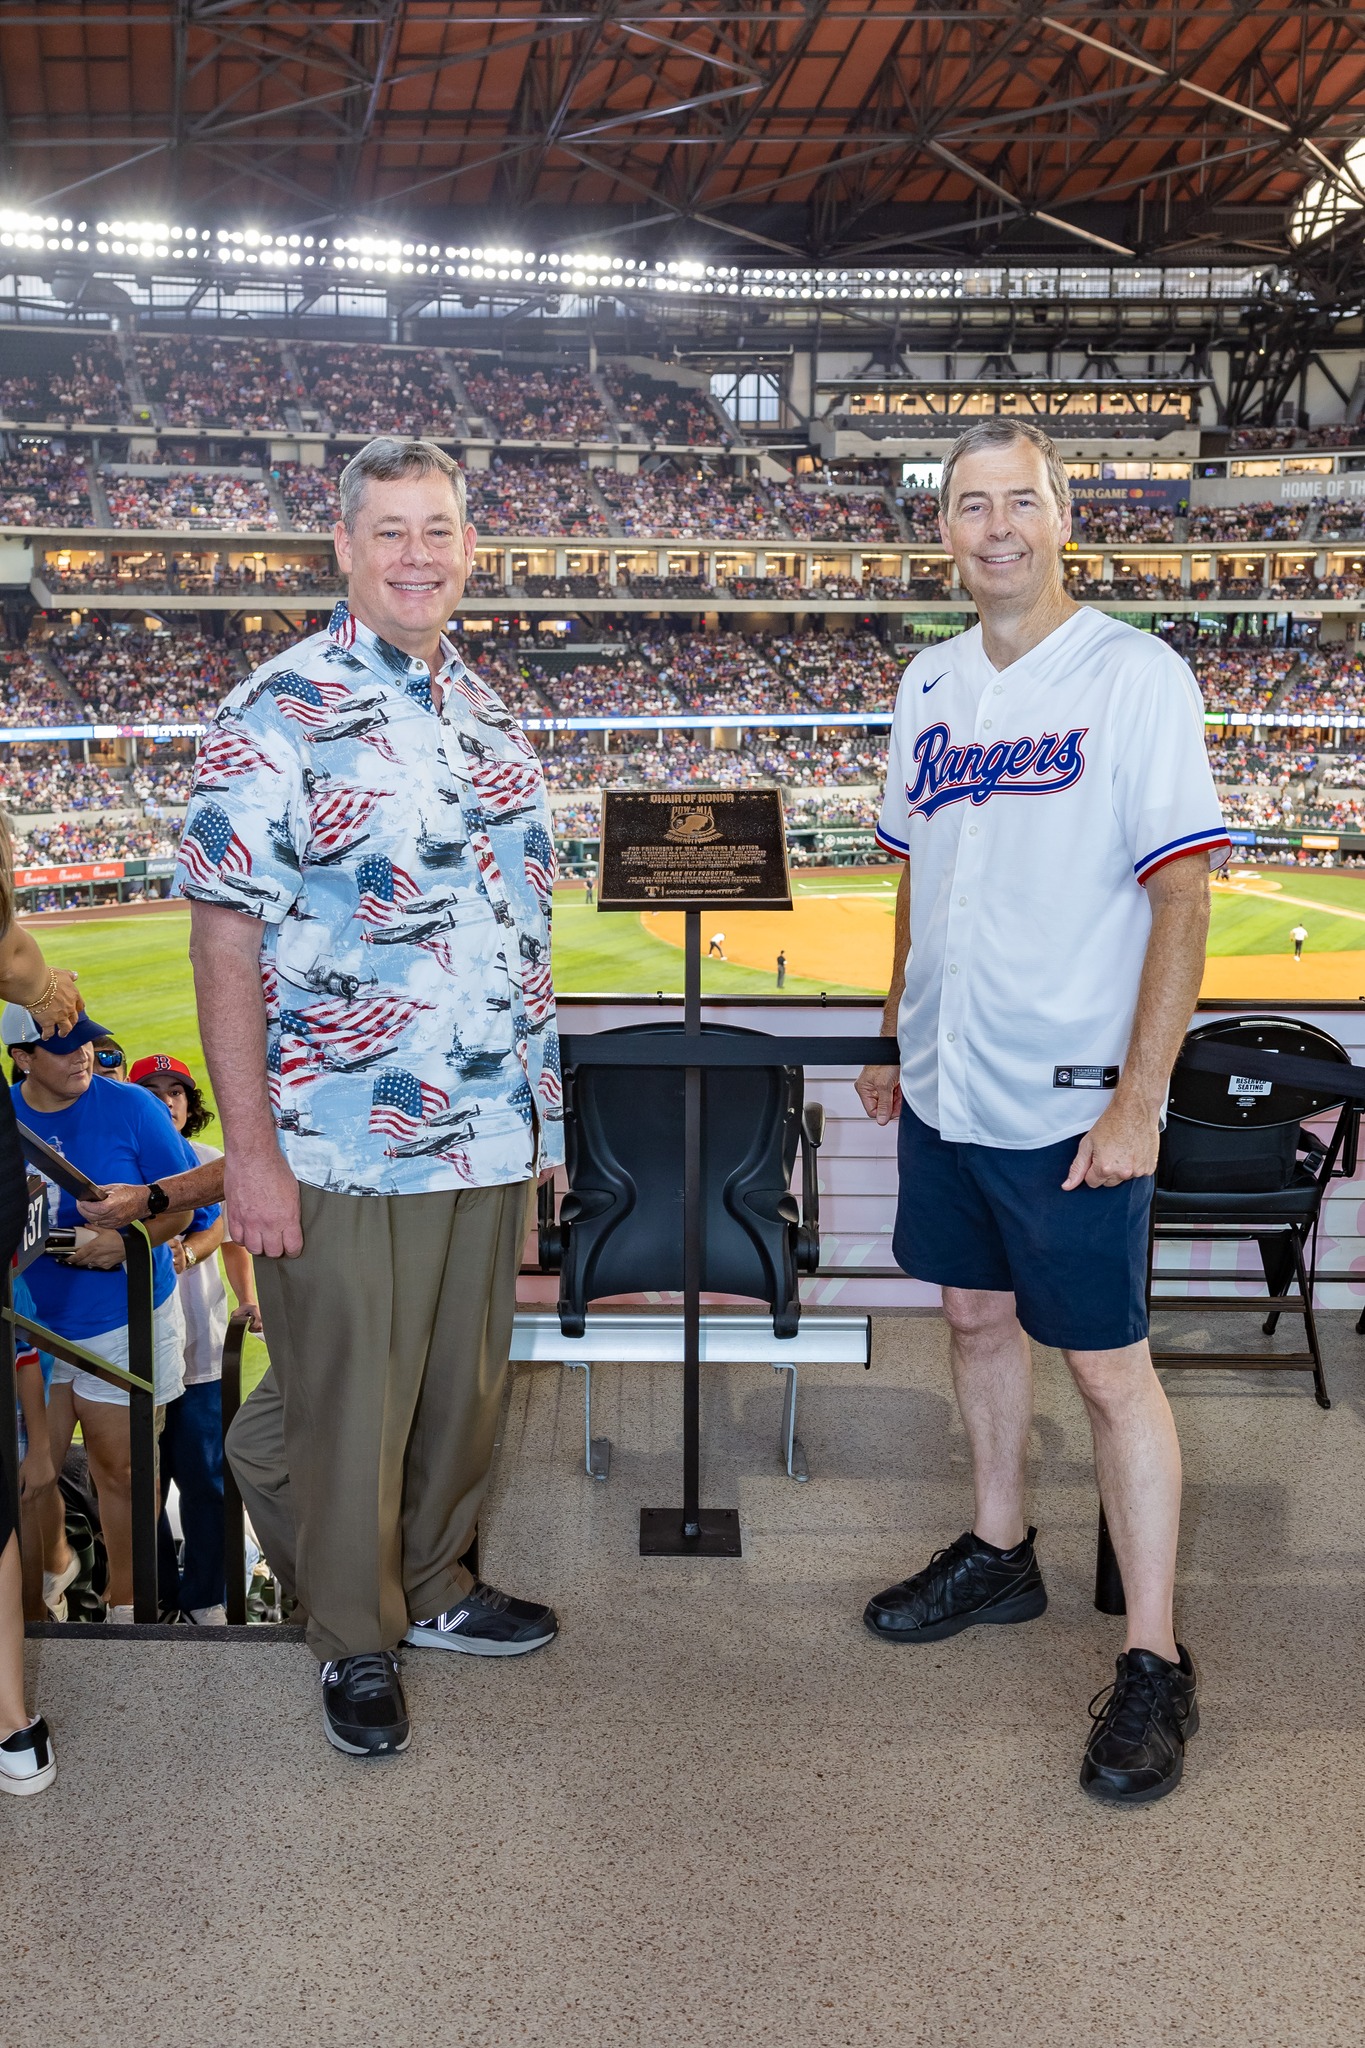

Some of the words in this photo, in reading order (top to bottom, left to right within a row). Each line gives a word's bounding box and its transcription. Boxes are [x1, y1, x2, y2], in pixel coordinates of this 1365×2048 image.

[1095, 487, 1128, 499] GAME
[1281, 481, 1323, 498] HOME
[1326, 480, 1345, 497] OF
[905, 722, 1089, 821] Rangers
[650, 794, 681, 803] CHAIR
[683, 794, 697, 803] OF
[697, 793, 735, 803] HONOR
[671, 806, 691, 819] POW
[696, 805, 715, 819] MIA
[153, 1055, 172, 1071] B
